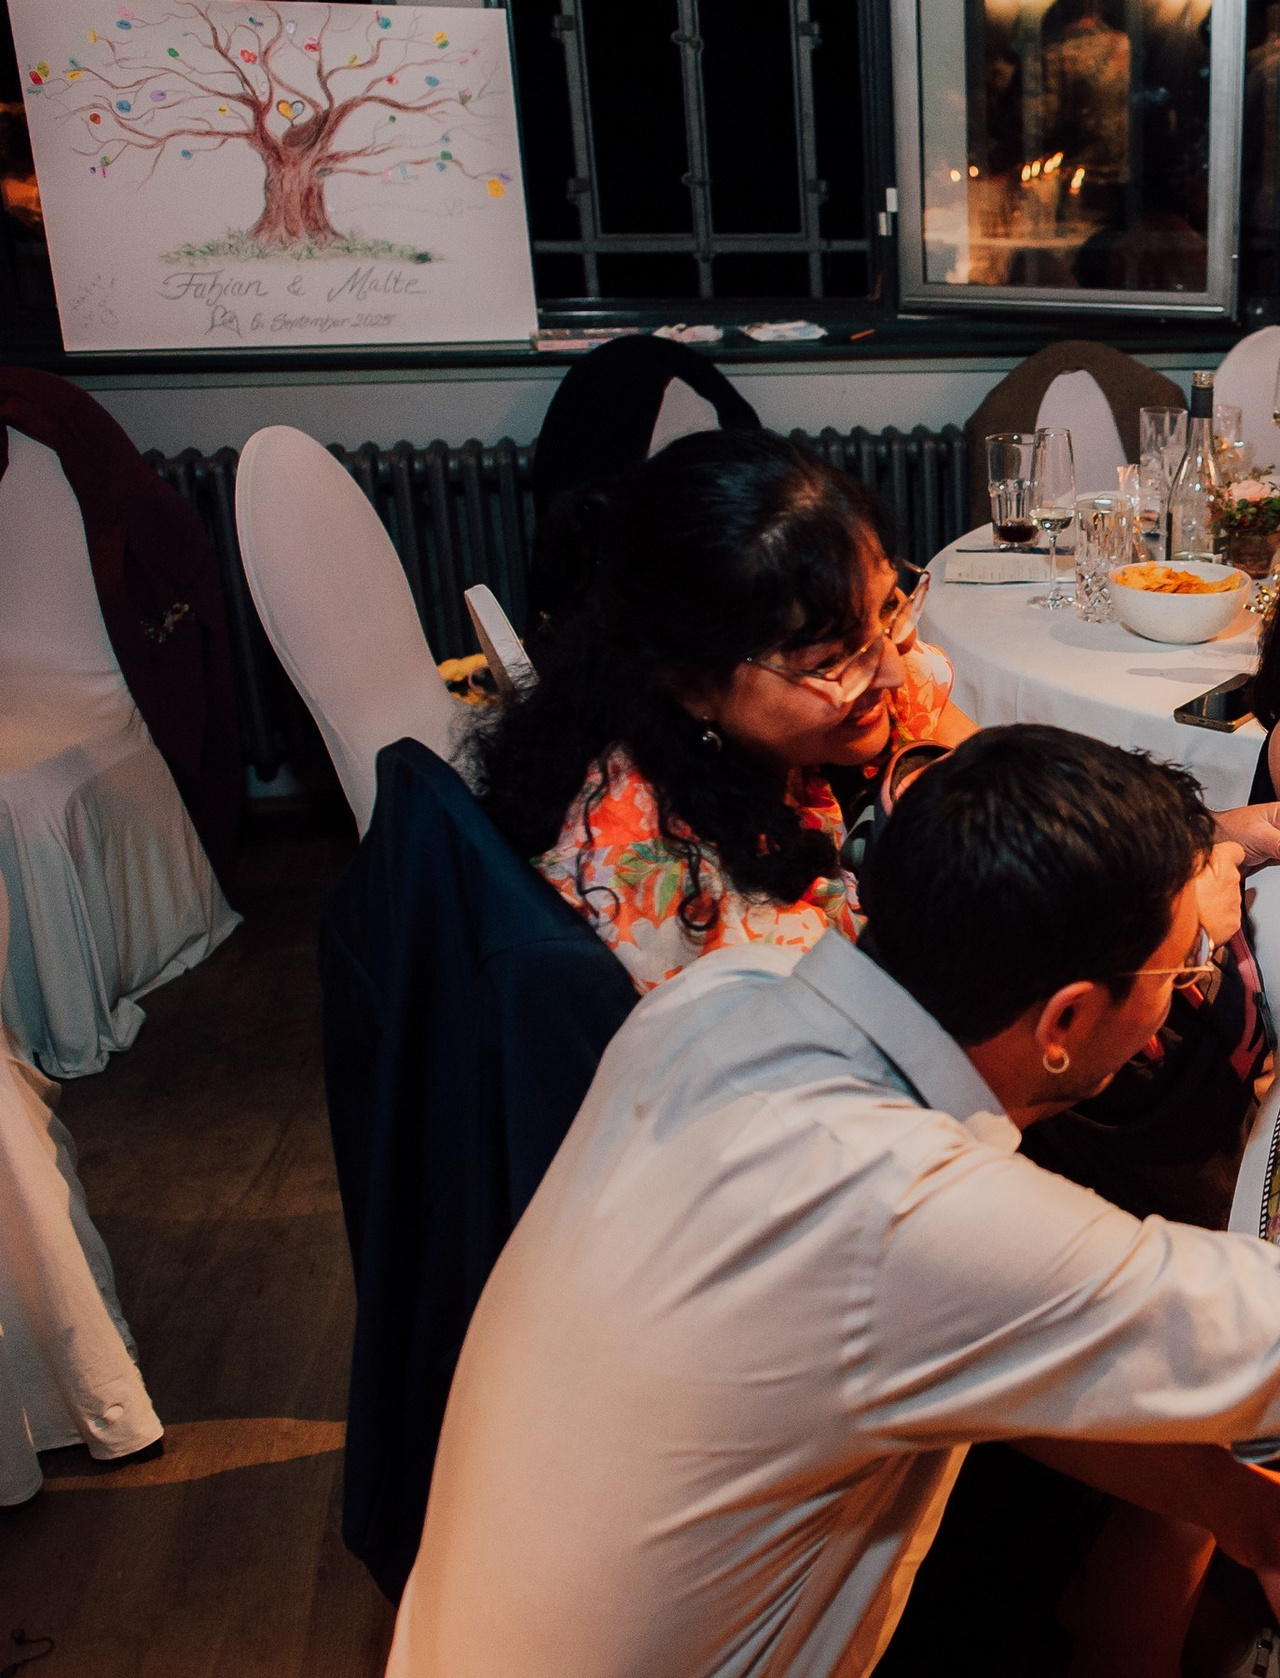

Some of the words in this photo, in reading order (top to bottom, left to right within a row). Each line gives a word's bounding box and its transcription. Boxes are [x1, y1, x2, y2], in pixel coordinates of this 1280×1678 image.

[157, 268, 268, 306] Fabian
[286, 275, 306, 296] &
[327, 266, 426, 302] Malte
[271, 312, 347, 333] September
[350, 312, 396, 328] 2025
